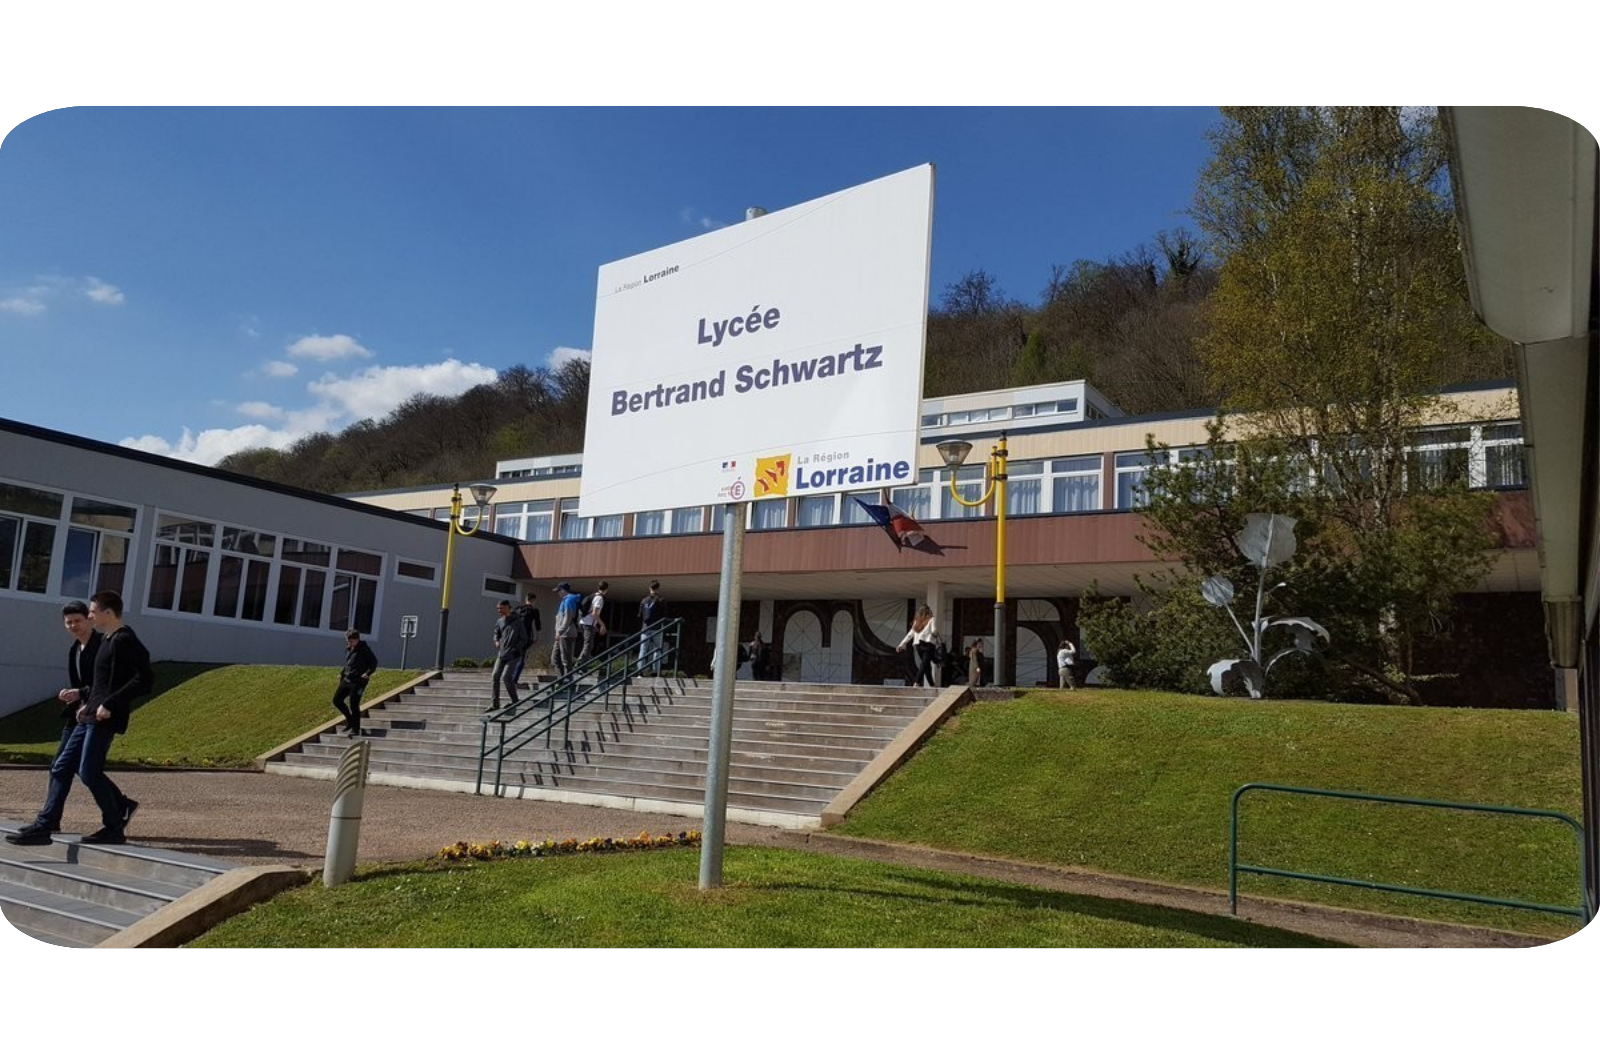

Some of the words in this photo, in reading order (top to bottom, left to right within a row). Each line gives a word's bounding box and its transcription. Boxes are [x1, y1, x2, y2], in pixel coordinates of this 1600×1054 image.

[643, 264, 680, 284] Lorraine
[697, 304, 781, 347] Lycée
[611, 369, 726, 416] Bertrand
[734, 343, 884, 394] Schwartz
[795, 458, 911, 490] Lorraine
[797, 455, 810, 465] La
[813, 451, 850, 464] Région
